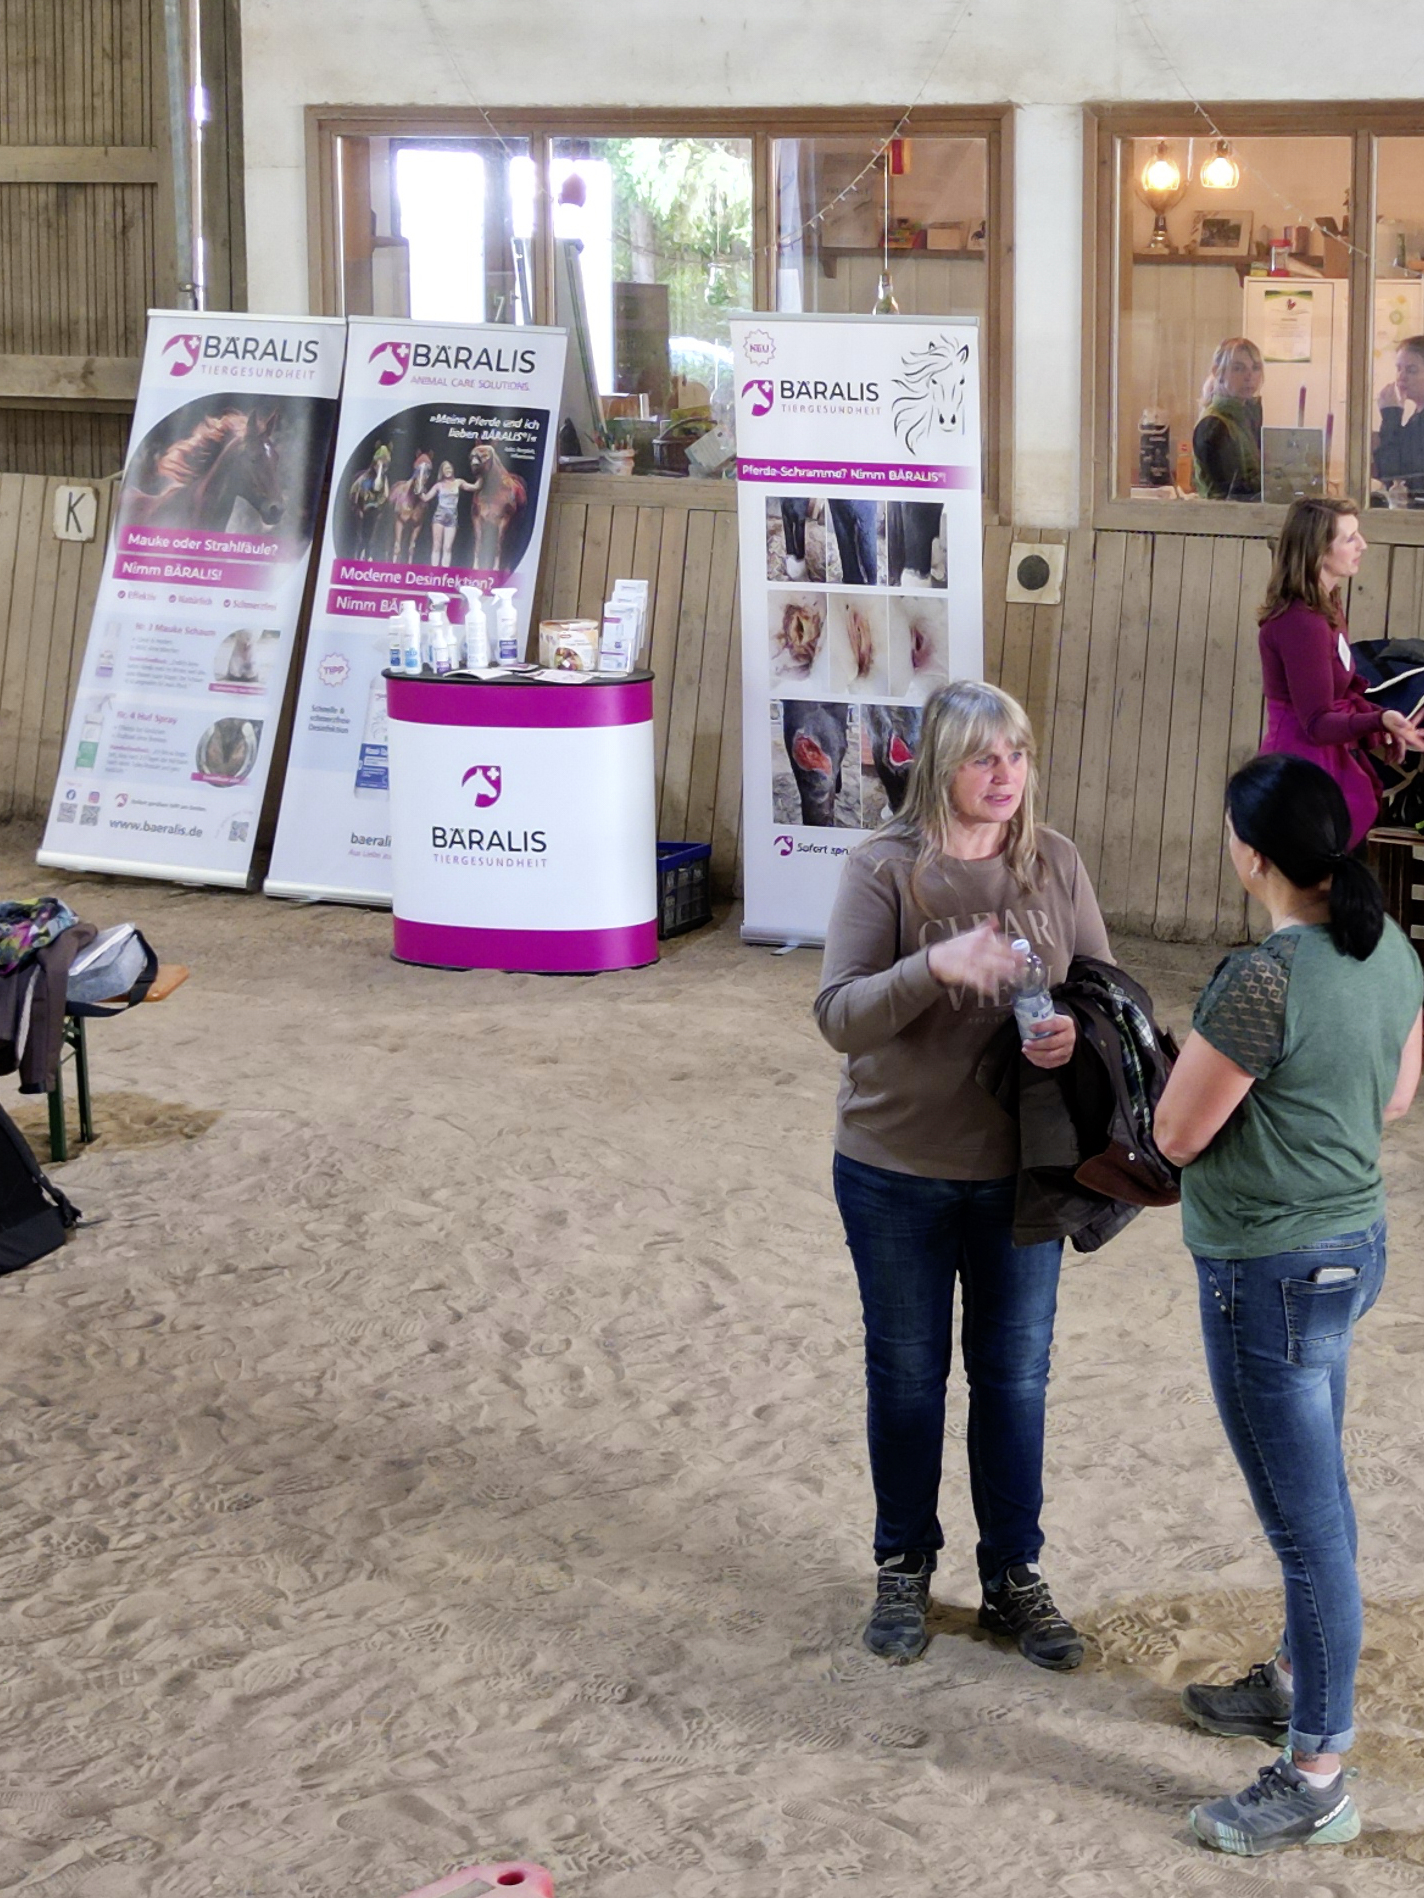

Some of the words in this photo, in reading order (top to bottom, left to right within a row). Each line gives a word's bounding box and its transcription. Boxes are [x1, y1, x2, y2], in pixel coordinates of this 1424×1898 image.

[202, 334, 320, 364] BÄRALIS
[749, 344, 770, 353] NEU
[412, 343, 536, 374] BÄRALIS
[201, 364, 316, 380] TIERGESUNDHEIT
[410, 376, 448, 387] ANIMAL
[451, 378, 475, 388] CARE
[780, 380, 879, 402] BÄRALIS
[781, 403, 882, 415] TIERGESUNDHEIT
[851, 468, 886, 480] Nimm
[66, 491, 87, 533] K
[128, 533, 170, 548] Mauke
[172, 536, 202, 550] oder
[204, 538, 279, 555] Strahlfäule?
[122, 561, 161, 576] Nimm
[164, 563, 223, 581] BÄRALIS!
[340, 566, 401, 583] Moderne
[405, 571, 495, 590] Desinfektion?
[335, 596, 376, 612] Nimm
[323, 665, 345, 675] TIPP
[109, 819, 203, 838] www.baeralis.de
[432, 826, 547, 853] BÄRALIS
[797, 843, 828, 854] Sofort
[433, 853, 547, 868] TIERGESUNDHEIT
